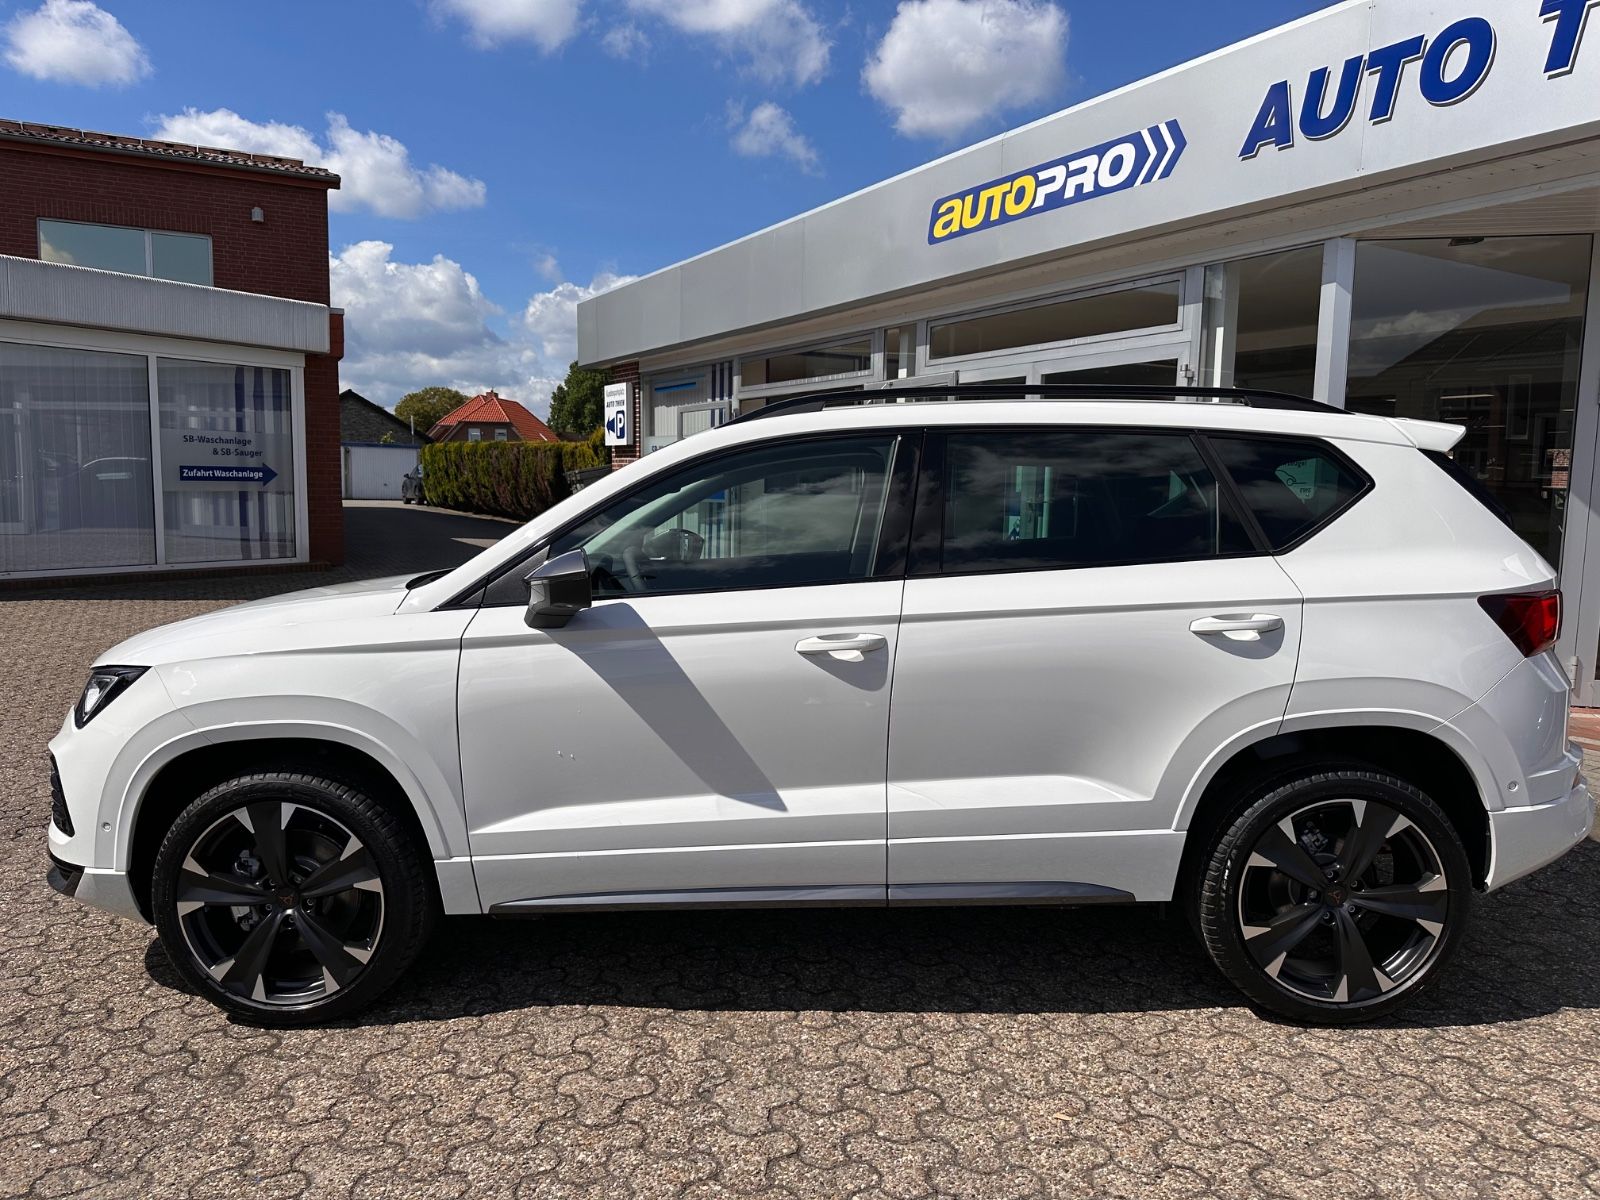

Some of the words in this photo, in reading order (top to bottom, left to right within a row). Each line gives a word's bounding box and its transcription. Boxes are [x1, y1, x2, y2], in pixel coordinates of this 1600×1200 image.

[1238, 16, 1496, 161] AUTO
[617, 413, 624, 437] P
[183, 435, 252, 446] SB-Waschanlage
[212, 447, 219, 456] &
[220, 448, 263, 458] SB-Sauger
[182, 469, 213, 477] Zufahrt
[214, 469, 263, 479] Waschanlage
